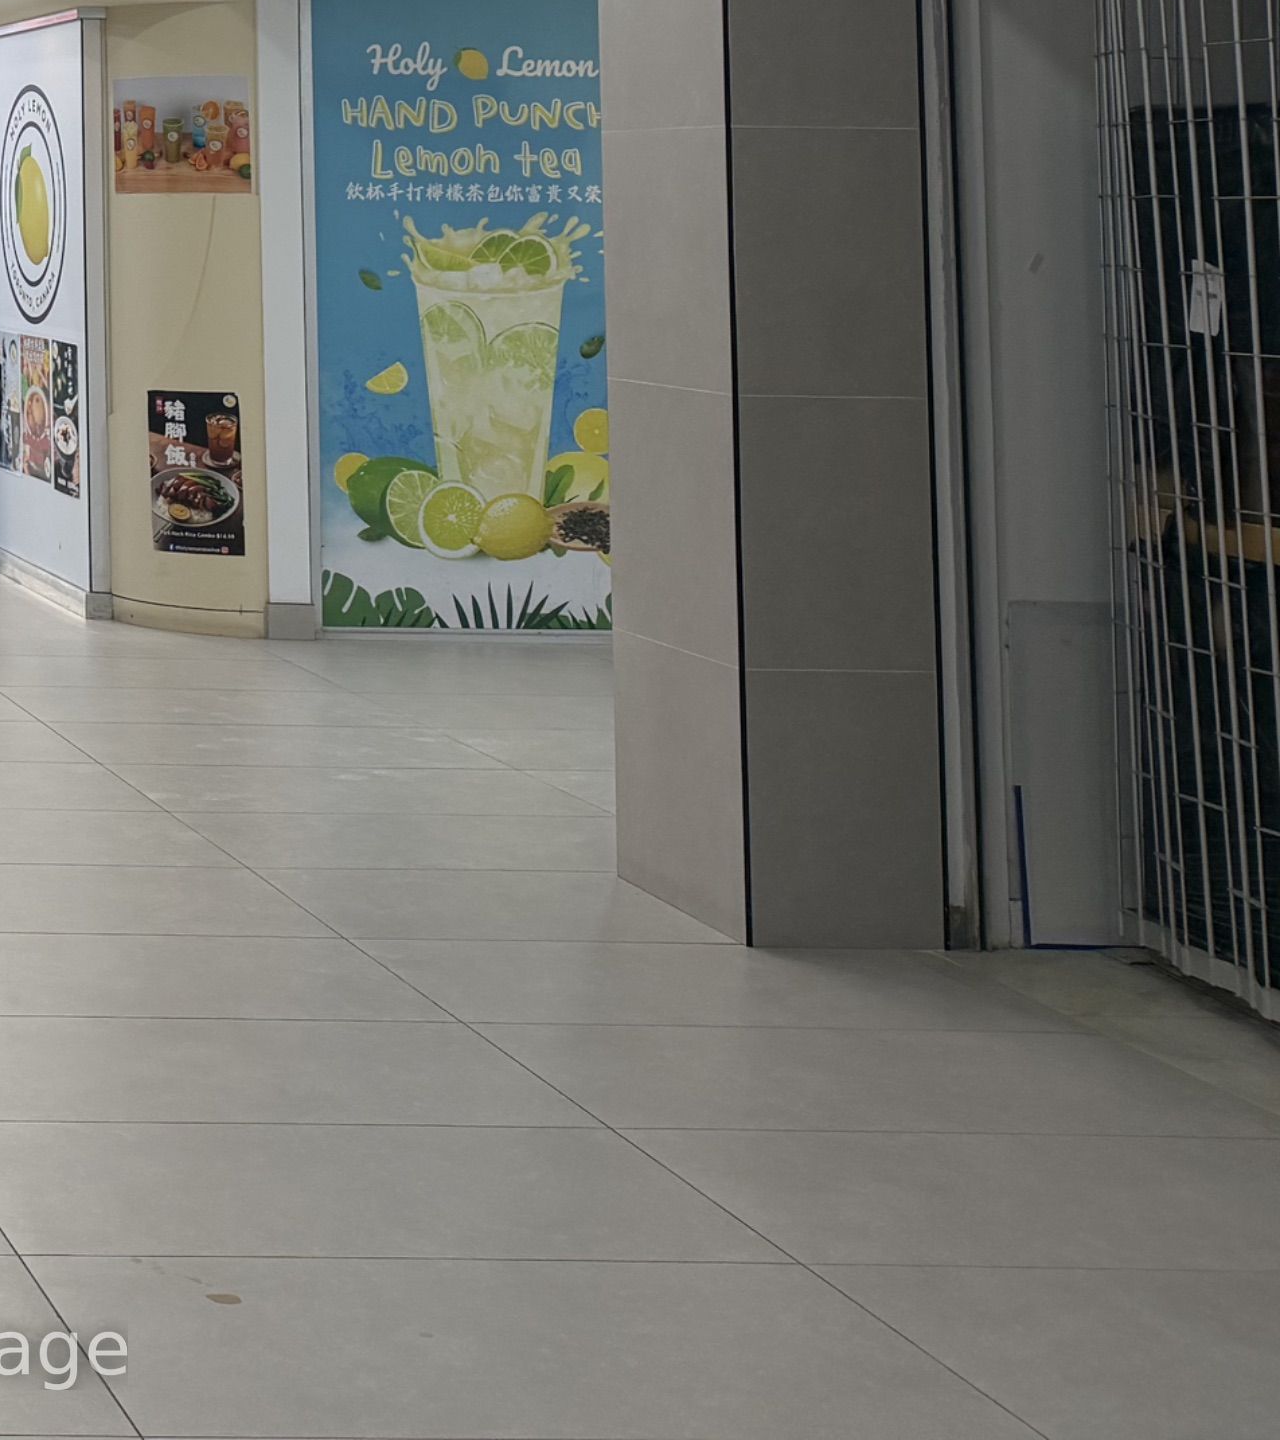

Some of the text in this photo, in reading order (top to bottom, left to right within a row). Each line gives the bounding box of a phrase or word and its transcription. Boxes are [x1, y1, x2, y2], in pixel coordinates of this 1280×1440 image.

[366, 41, 600, 91] Holy Lemon
[26, 98, 52, 135] LEMON
[341, 94, 458, 133] HAND
[371, 138, 582, 179] Lemon tea
